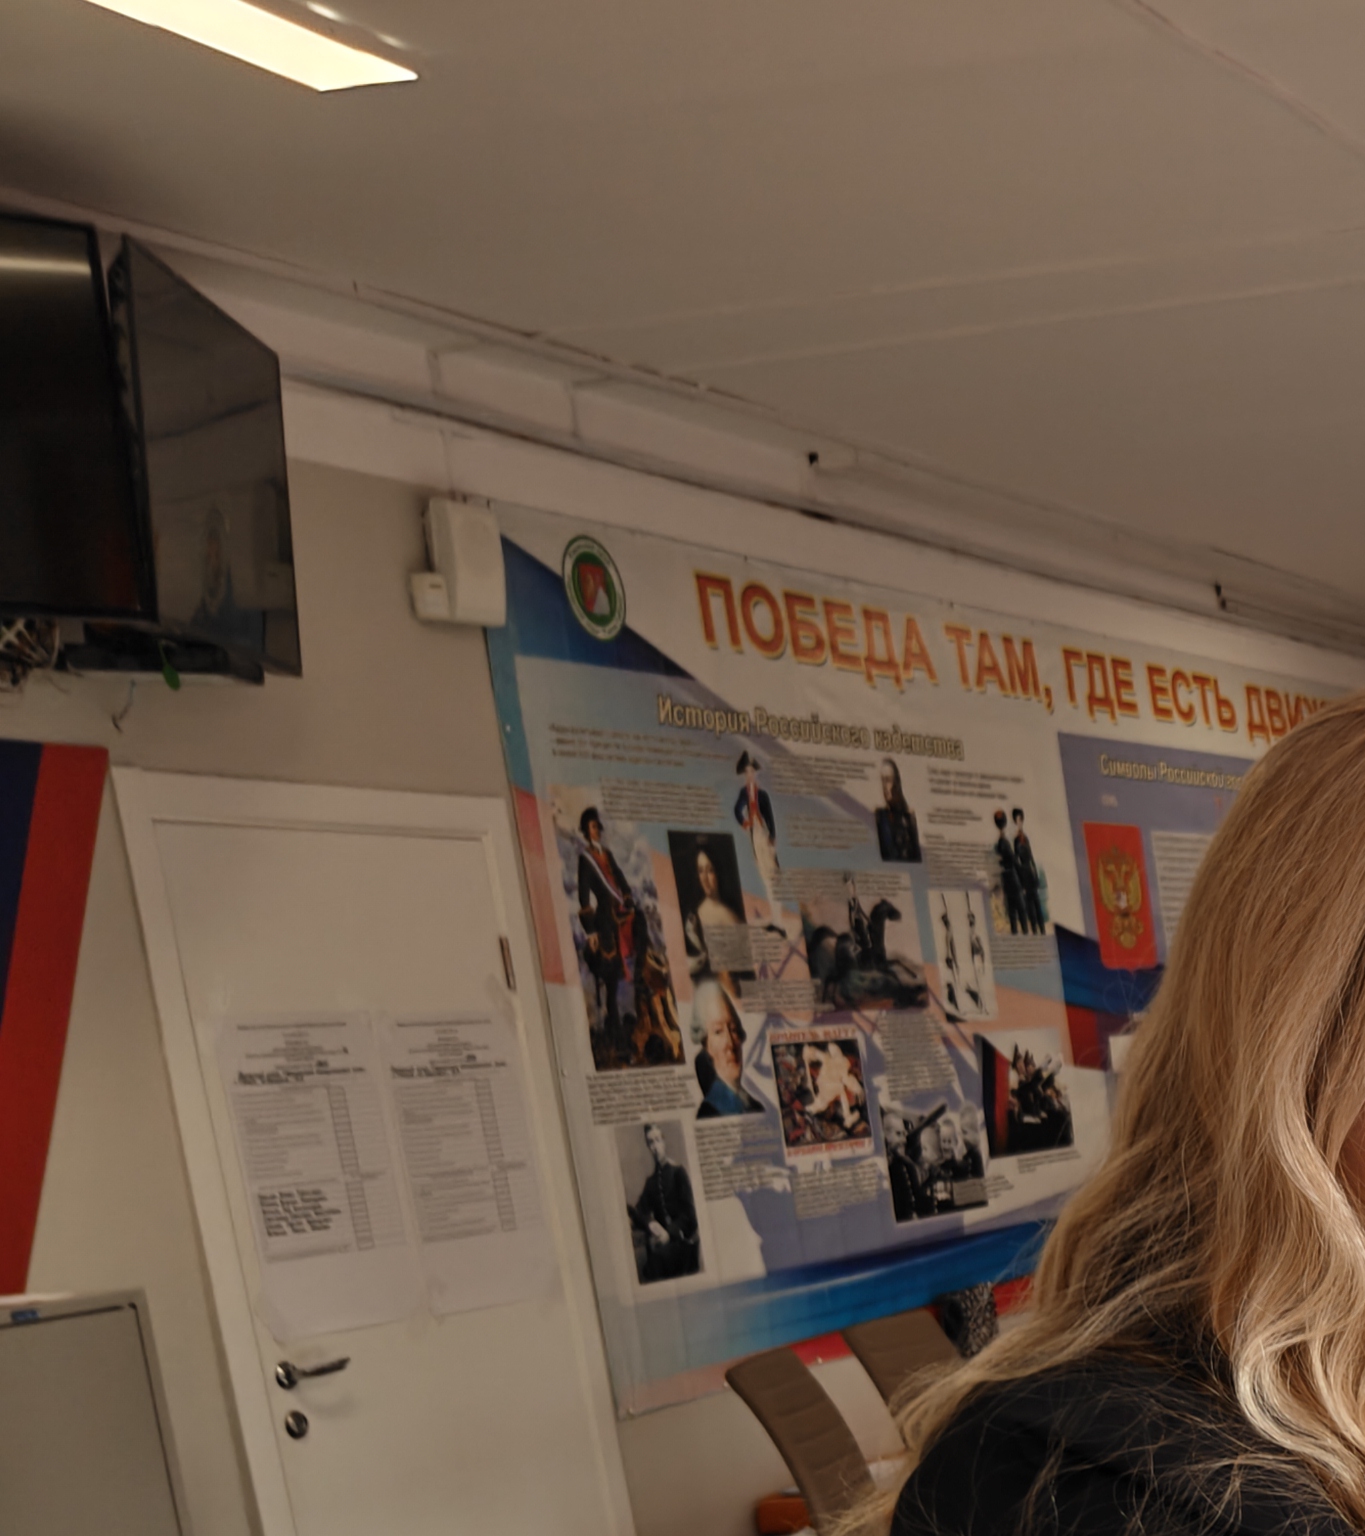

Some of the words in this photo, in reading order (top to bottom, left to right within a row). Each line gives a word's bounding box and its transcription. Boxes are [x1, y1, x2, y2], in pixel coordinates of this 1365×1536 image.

[693, 569, 939, 693] ПОБЕДА
[943, 623, 1055, 714] ТАМ,
[1060, 646, 1139, 725] ГДЕ
[1145, 661, 1238, 732] ЕСТЬ
[657, 695, 750, 736] История
[754, 706, 871, 749] Российского
[873, 724, 965, 760] кадетства
[1099, 754, 1157, 781] Символы
